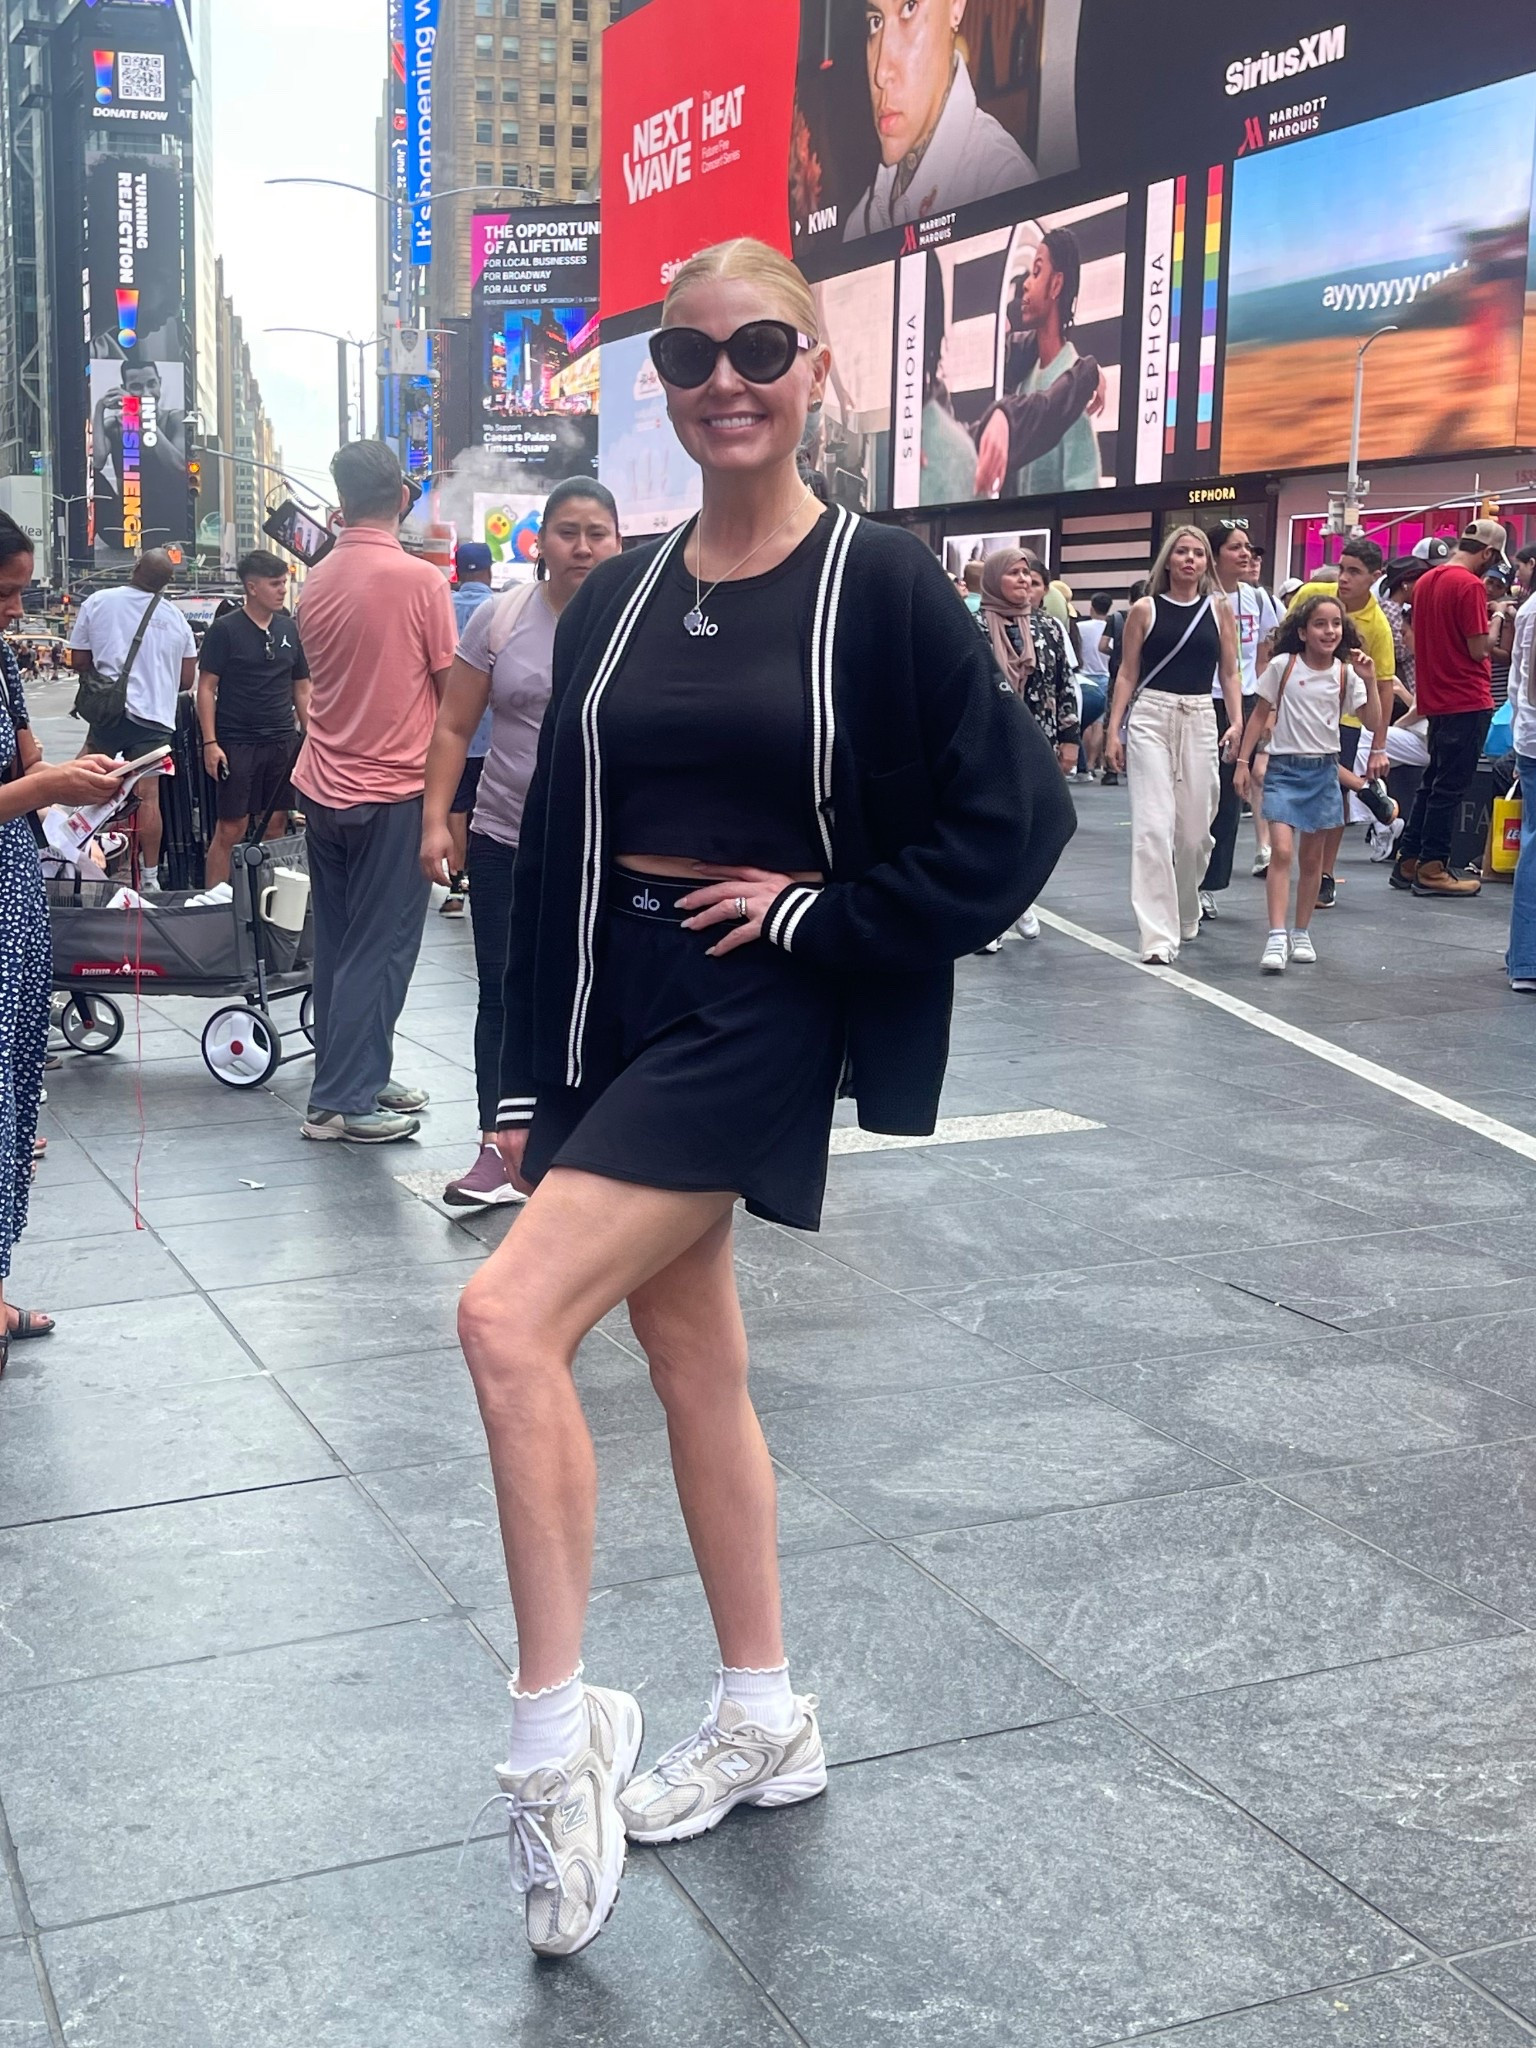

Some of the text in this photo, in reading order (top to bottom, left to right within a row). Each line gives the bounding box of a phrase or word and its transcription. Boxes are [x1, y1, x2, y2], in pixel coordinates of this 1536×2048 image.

[1225, 25, 1346, 95] SiriusXM
[93, 107, 169, 121] DONATE NOW
[702, 84, 745, 142] HEAT
[1269, 96, 1327, 125] MARRIOTT
[633, 97, 693, 163] NEXT
[1268, 116, 1319, 142] MARQUIS
[623, 140, 692, 205] WAVE
[135, 173, 149, 249] TURNING
[808, 205, 838, 235] KWN
[919, 213, 957, 232] MARRIOTT
[118, 172, 134, 284] REJECTION
[415, 205, 432, 247] It's
[484, 225, 514, 239] THE
[919, 228, 952, 245] MARQUIS
[483, 238, 588, 255] OF A LIFETIME
[483, 255, 588, 268] FOR LOCAL BUSINESSES
[483, 270, 552, 281] FOR BROADWAY
[483, 283, 547, 294] FOR ALL OF US
[1143, 253, 1165, 424] SEPHORA
[902, 314, 917, 459] SEPHORA
[141, 396, 158, 447] INTO
[483, 431, 557, 443] Caesars Palace
[484, 442, 550, 455] Times Square
[121, 395, 142, 548] RESILIENCE
[1189, 486, 1236, 504] SEPHORA
[689, 617, 719, 637] alo
[632, 888, 660, 912] alo
